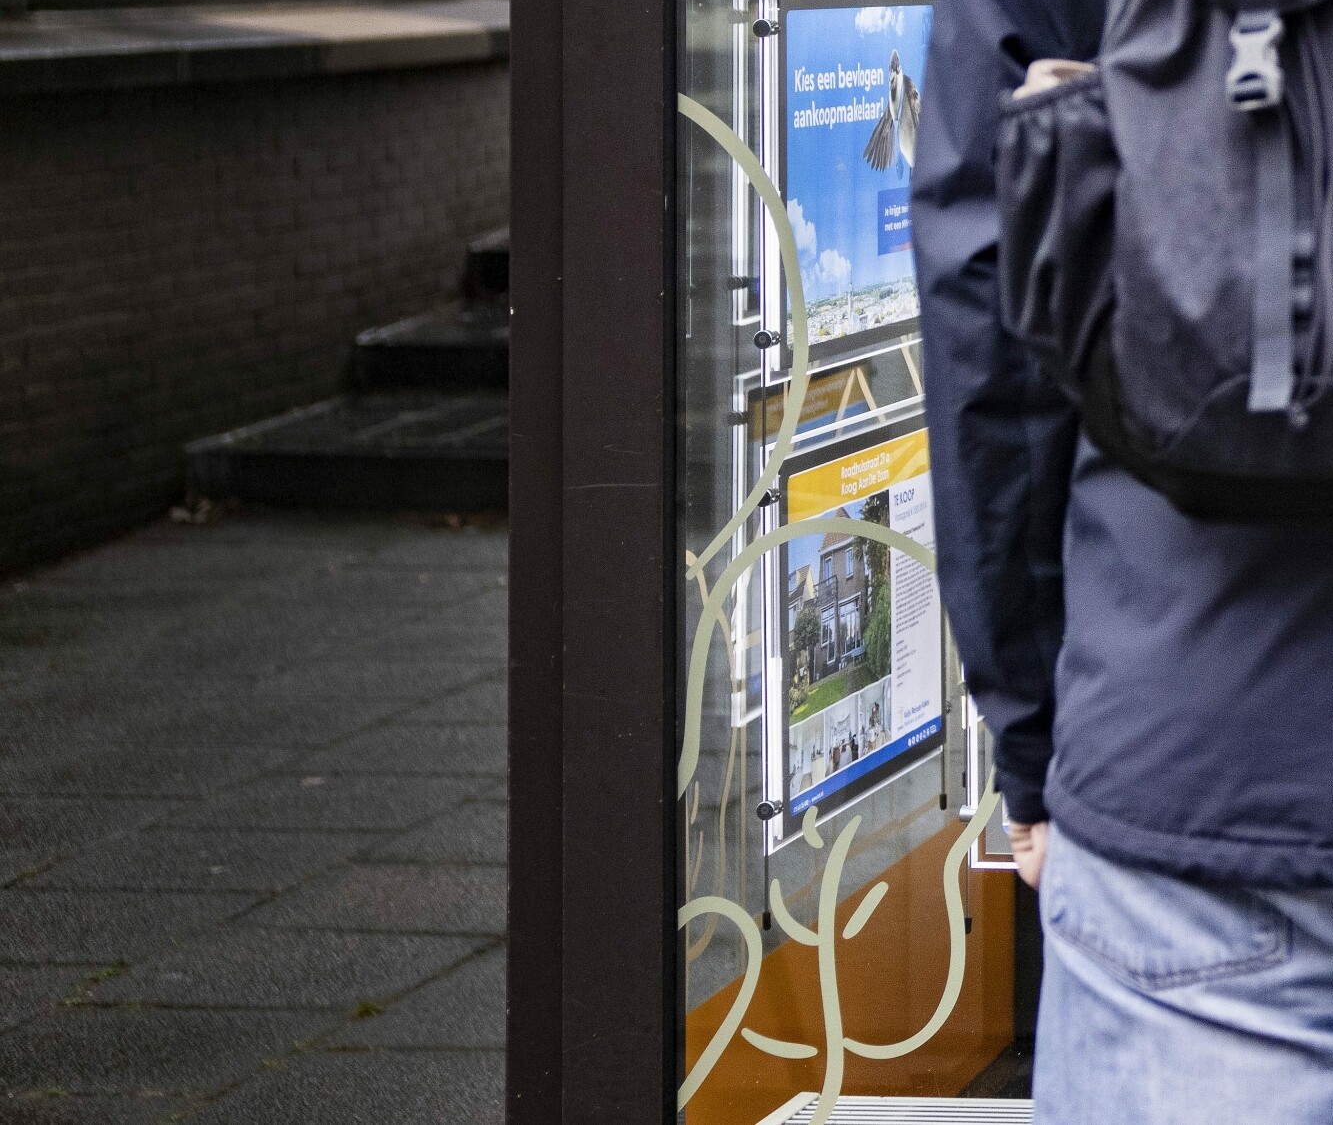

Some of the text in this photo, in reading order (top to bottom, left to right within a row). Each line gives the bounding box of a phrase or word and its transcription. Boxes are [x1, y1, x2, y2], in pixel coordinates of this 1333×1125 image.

[794, 63, 884, 92] Kies een bevlogen
[794, 96, 884, 130] aankoopmakelaar!
